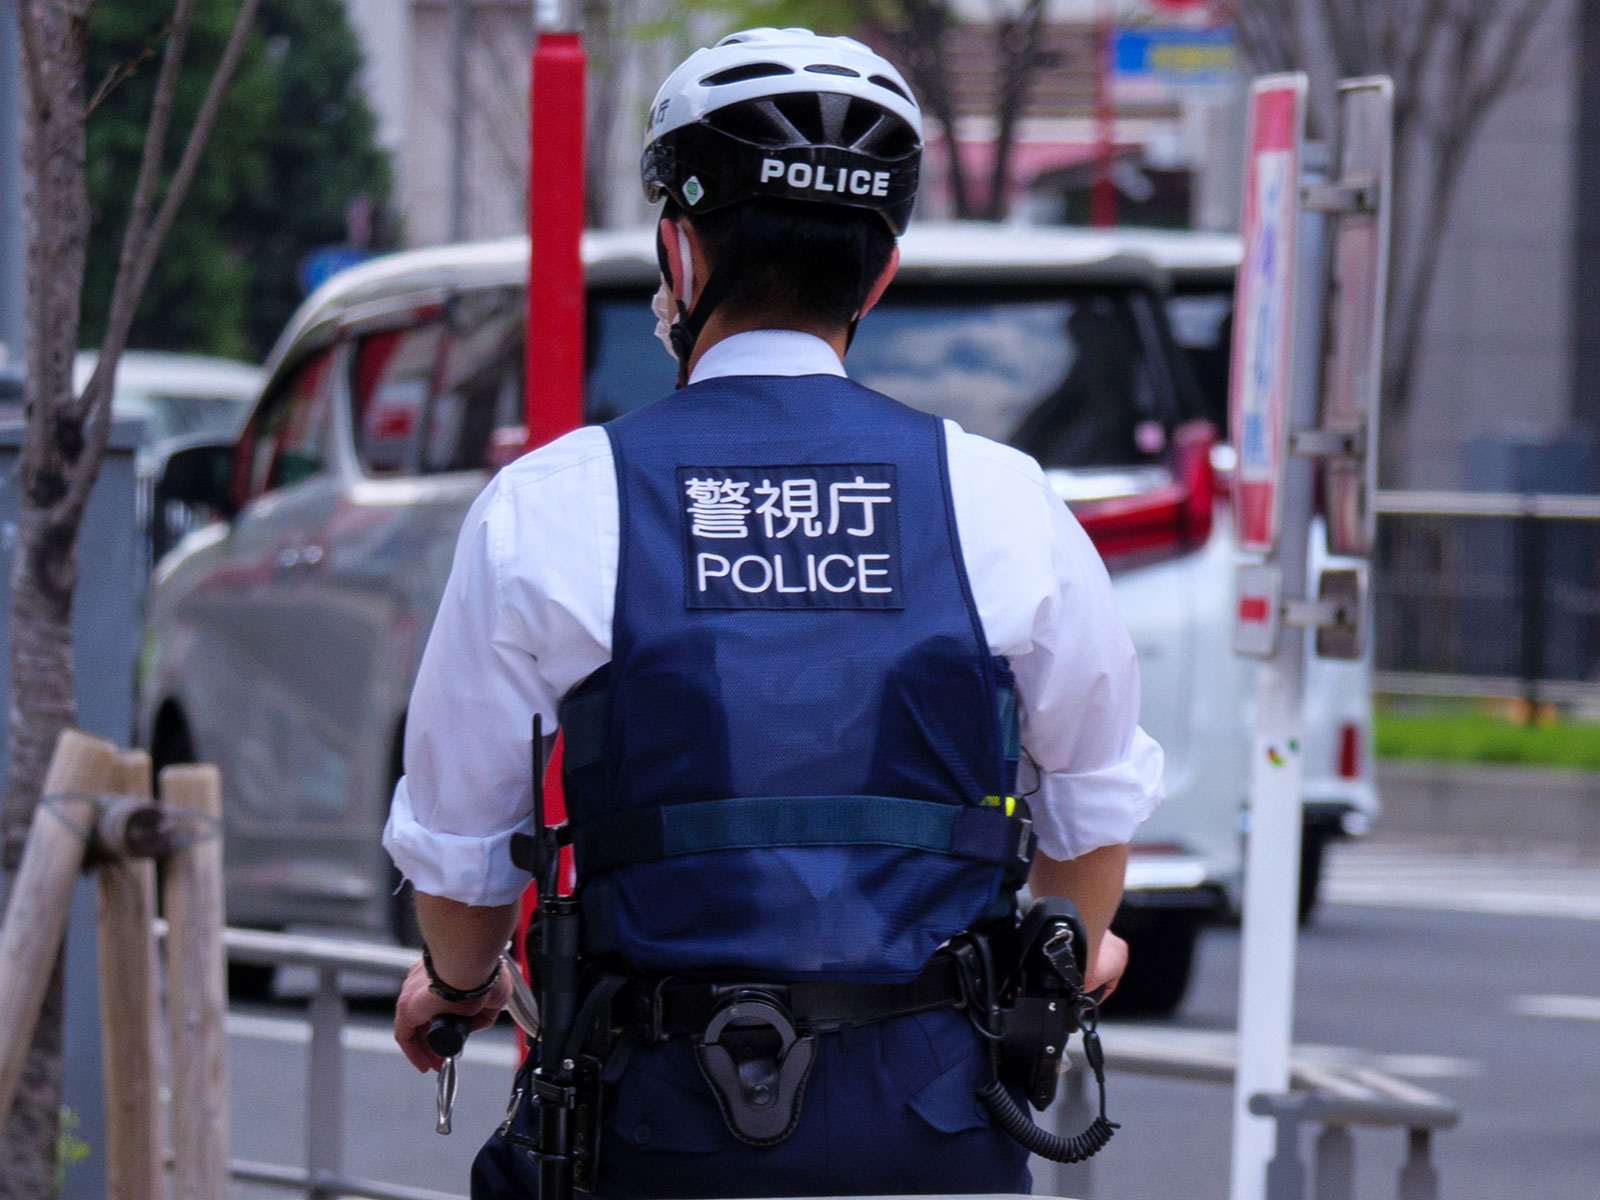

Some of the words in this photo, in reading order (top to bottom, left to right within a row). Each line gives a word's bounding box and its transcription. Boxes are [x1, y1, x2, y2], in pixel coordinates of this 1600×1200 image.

[760, 158, 890, 197] POLICE
[685, 476, 892, 538] 警視庁
[697, 552, 893, 593] POLICE
